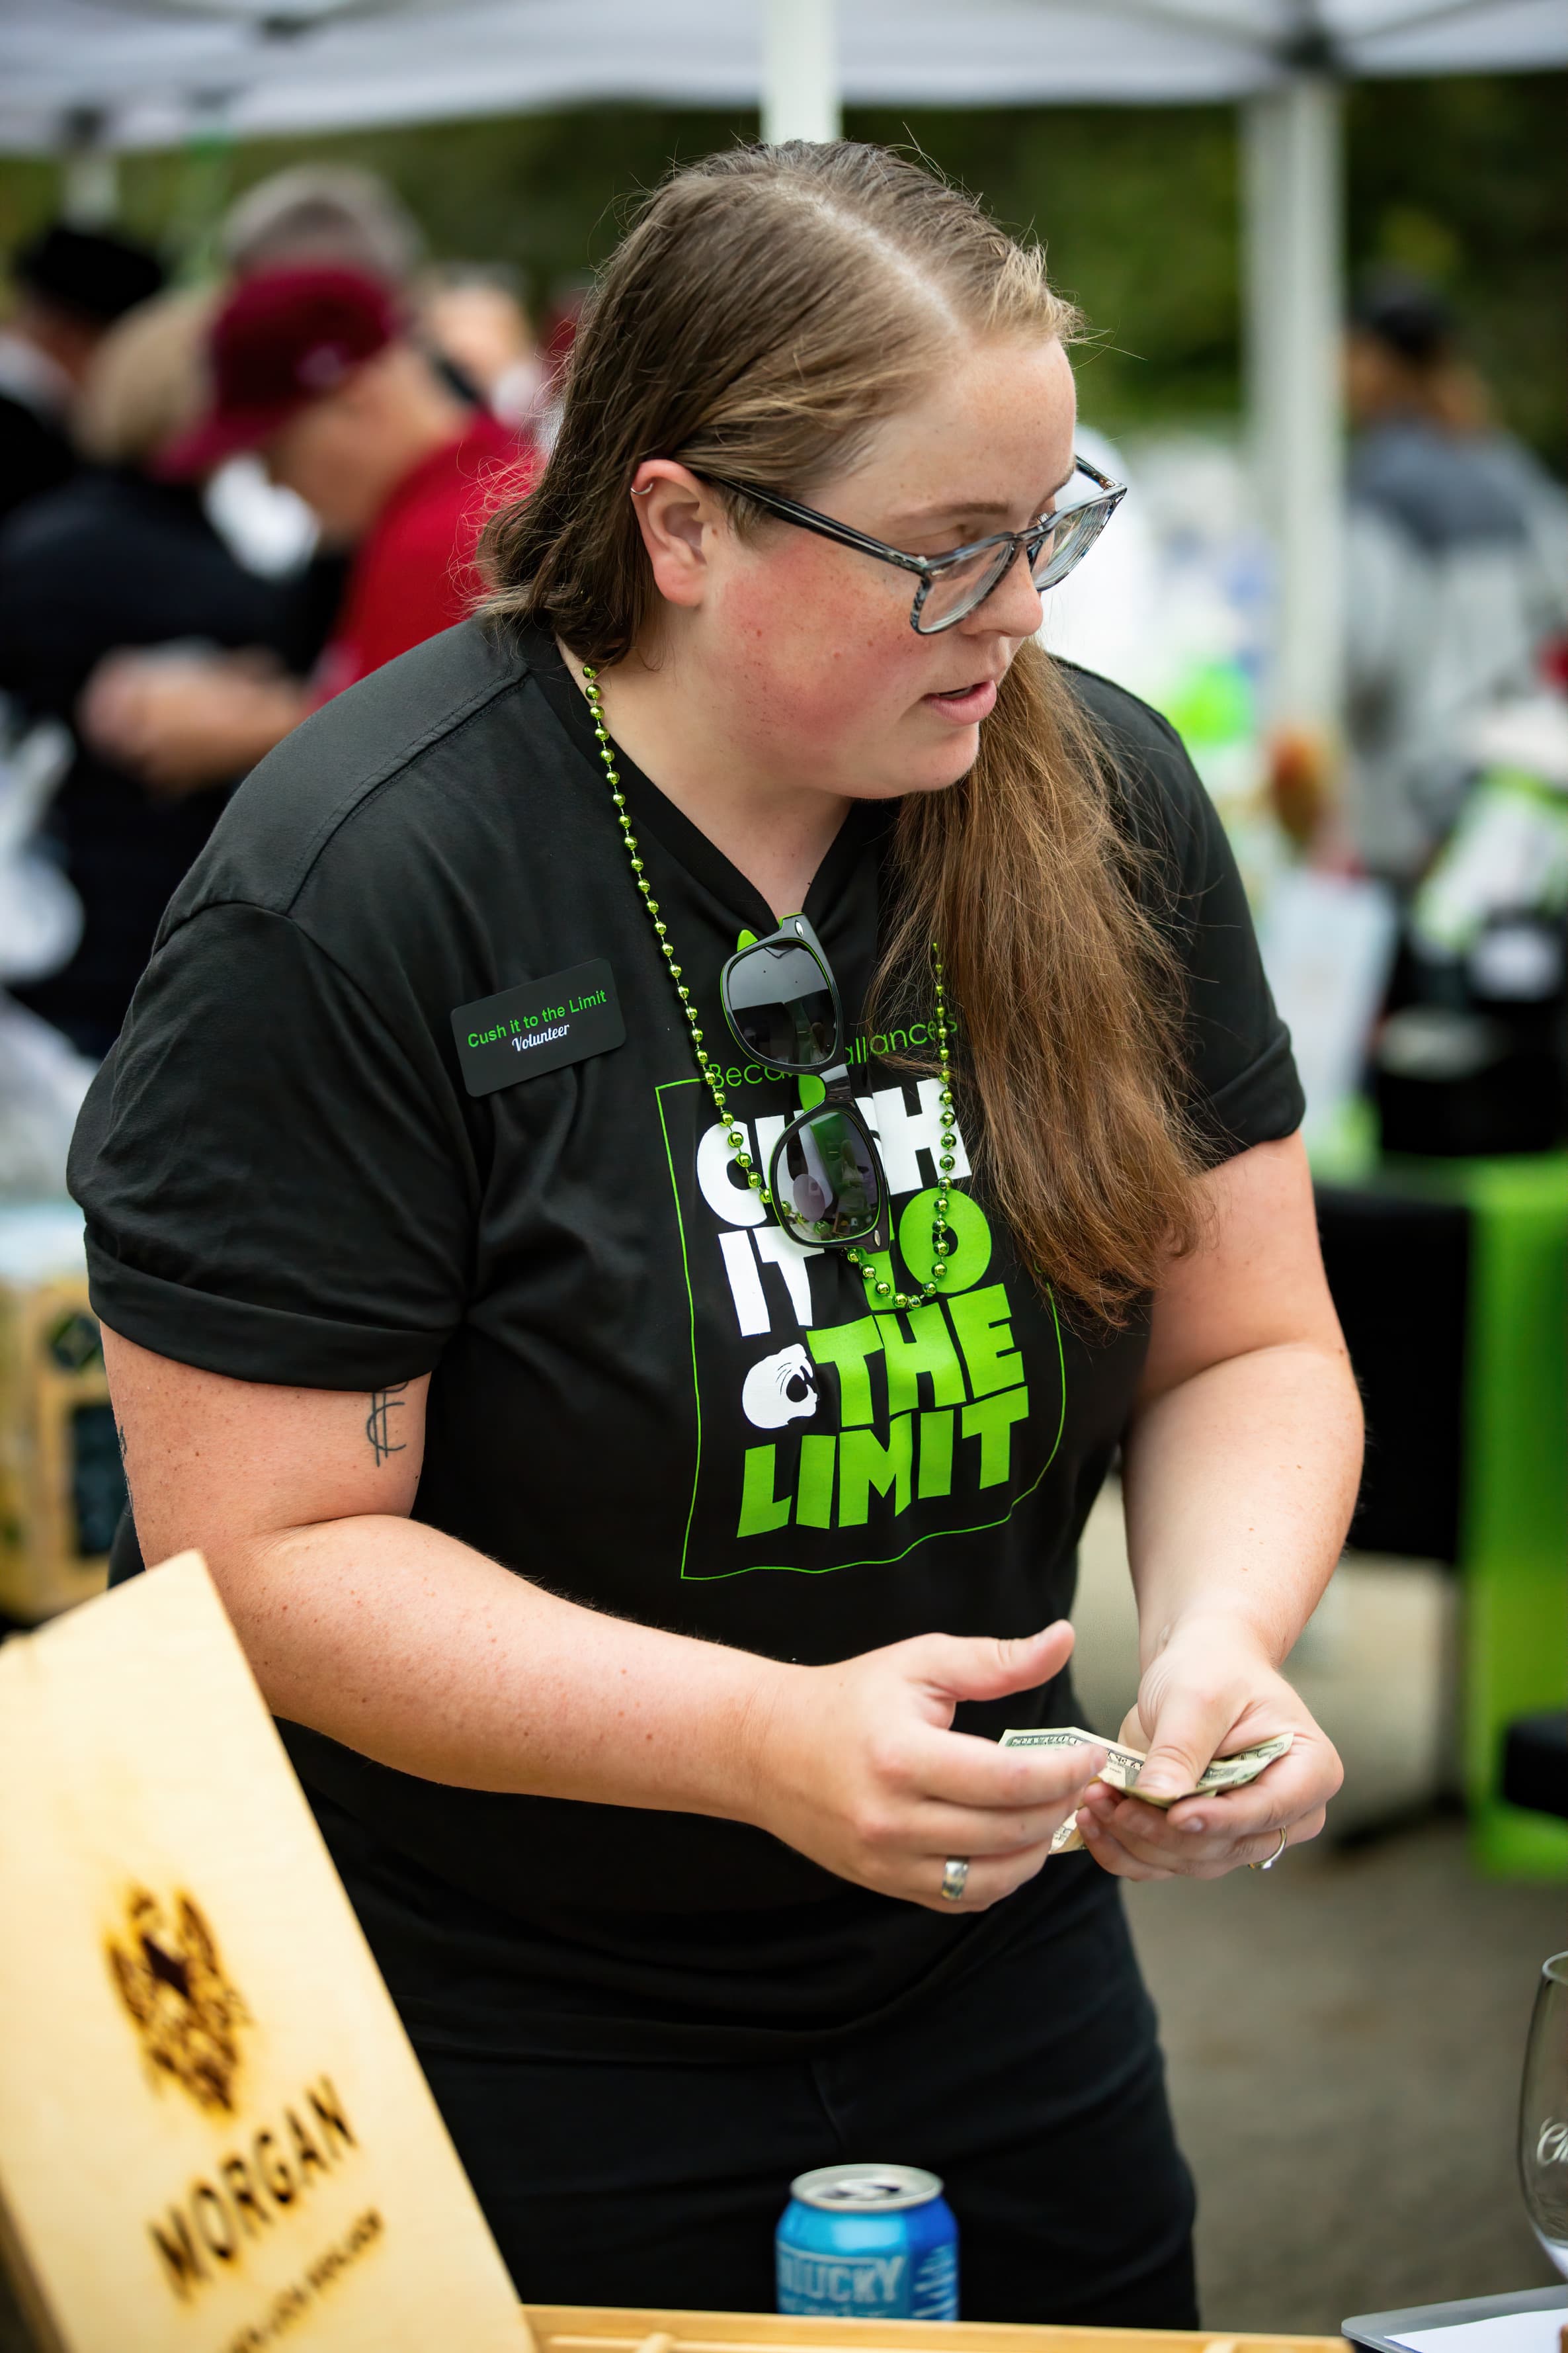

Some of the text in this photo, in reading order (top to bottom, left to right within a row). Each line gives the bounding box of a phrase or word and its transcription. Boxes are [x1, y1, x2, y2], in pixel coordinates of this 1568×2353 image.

[468, 990, 607, 1047] Cush it to the Limit
[512, 1025, 569, 1051] Volunteer
[718, 1219, 825, 1338] IT
[806, 1283, 1024, 1428] THE
[737, 1385, 1029, 1537] LIMIT
[145, 2075, 359, 2305] MORGAN
